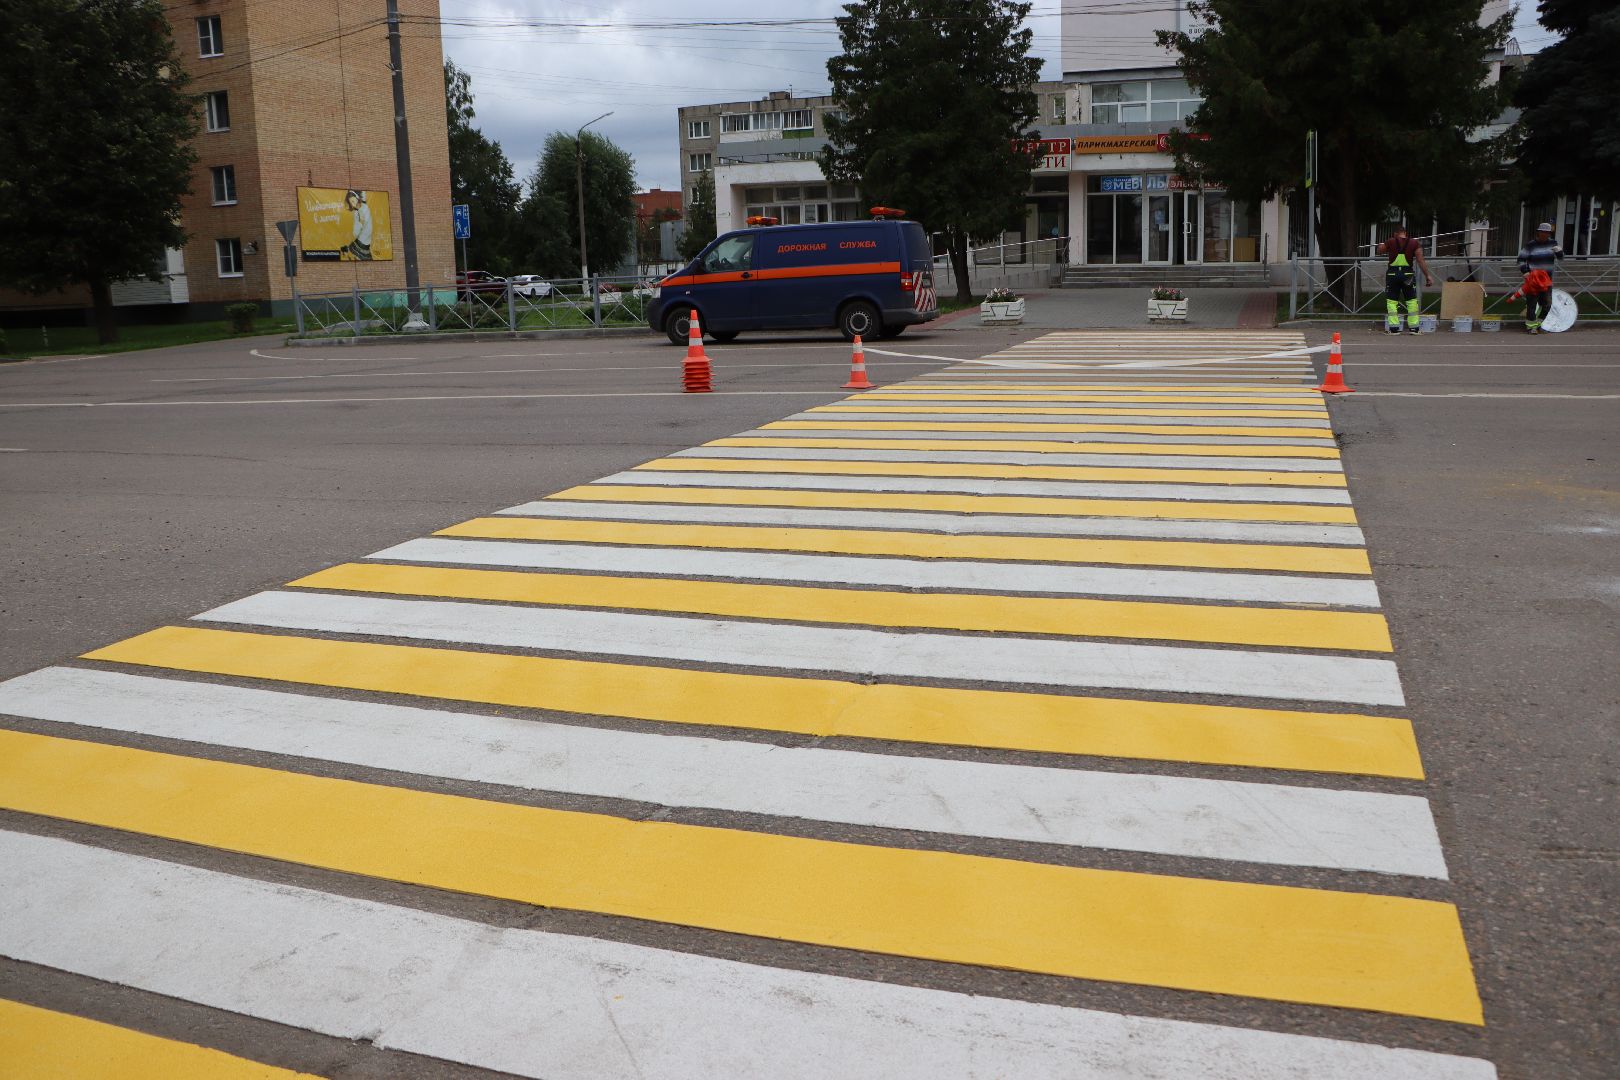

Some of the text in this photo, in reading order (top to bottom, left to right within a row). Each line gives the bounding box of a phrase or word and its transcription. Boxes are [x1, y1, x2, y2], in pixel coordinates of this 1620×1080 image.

[1077, 139, 1156, 149] ПАРИКМАХЕРСКАЯ
[1113, 176, 1166, 190] МЕБЛЬ
[777, 240, 877, 253] ДОРОЖНАЯ СЛУЖБА
